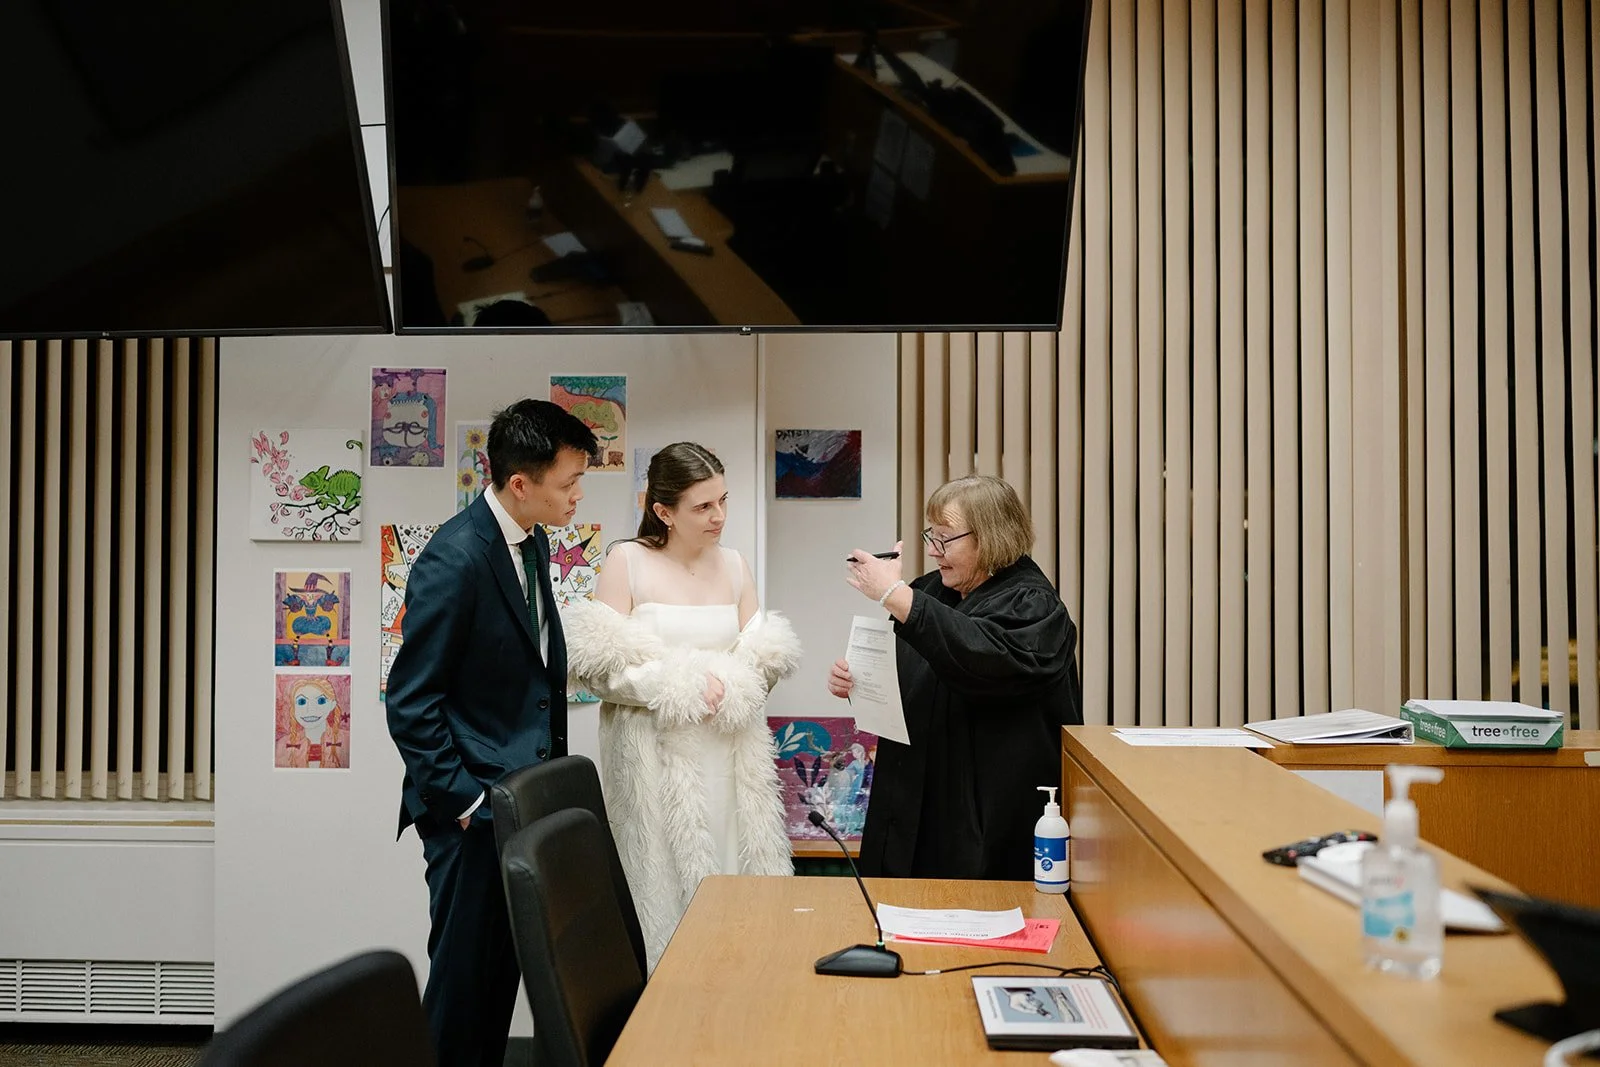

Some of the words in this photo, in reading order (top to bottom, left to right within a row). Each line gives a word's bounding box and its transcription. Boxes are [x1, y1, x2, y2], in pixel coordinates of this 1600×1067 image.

[564, 553, 574, 565] 6
[1472, 725, 1501, 737] tree
[1510, 725, 1540, 738] free
